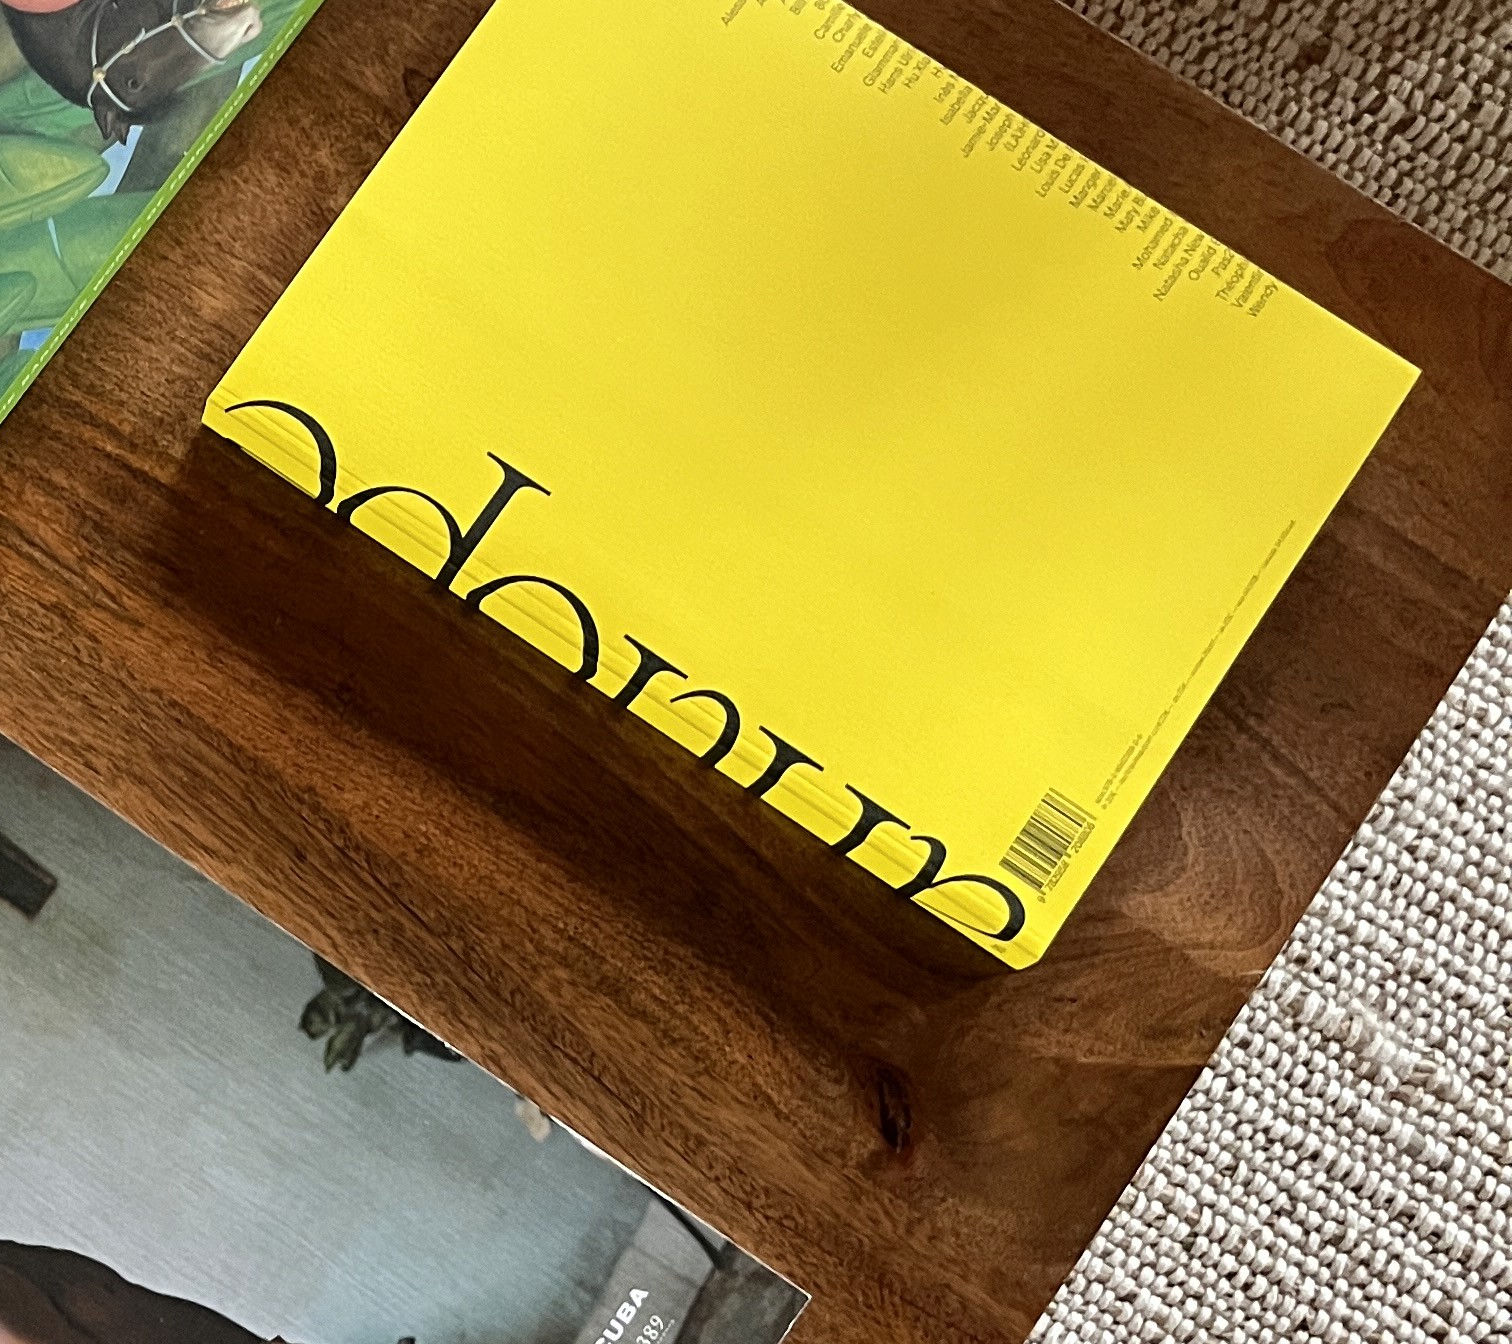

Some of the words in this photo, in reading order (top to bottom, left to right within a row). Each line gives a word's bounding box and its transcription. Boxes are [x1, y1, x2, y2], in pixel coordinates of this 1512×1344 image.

[829, 20, 873, 74] Emanuele
[937, 83, 973, 126] Isabella
[983, 111, 1018, 152] Joseph
[1033, 166, 1061, 198] Louis
[1057, 160, 1087, 194] Lucas
[1130, 216, 1174, 270] Mohamed
[1151, 254, 1190, 301] Natasha
